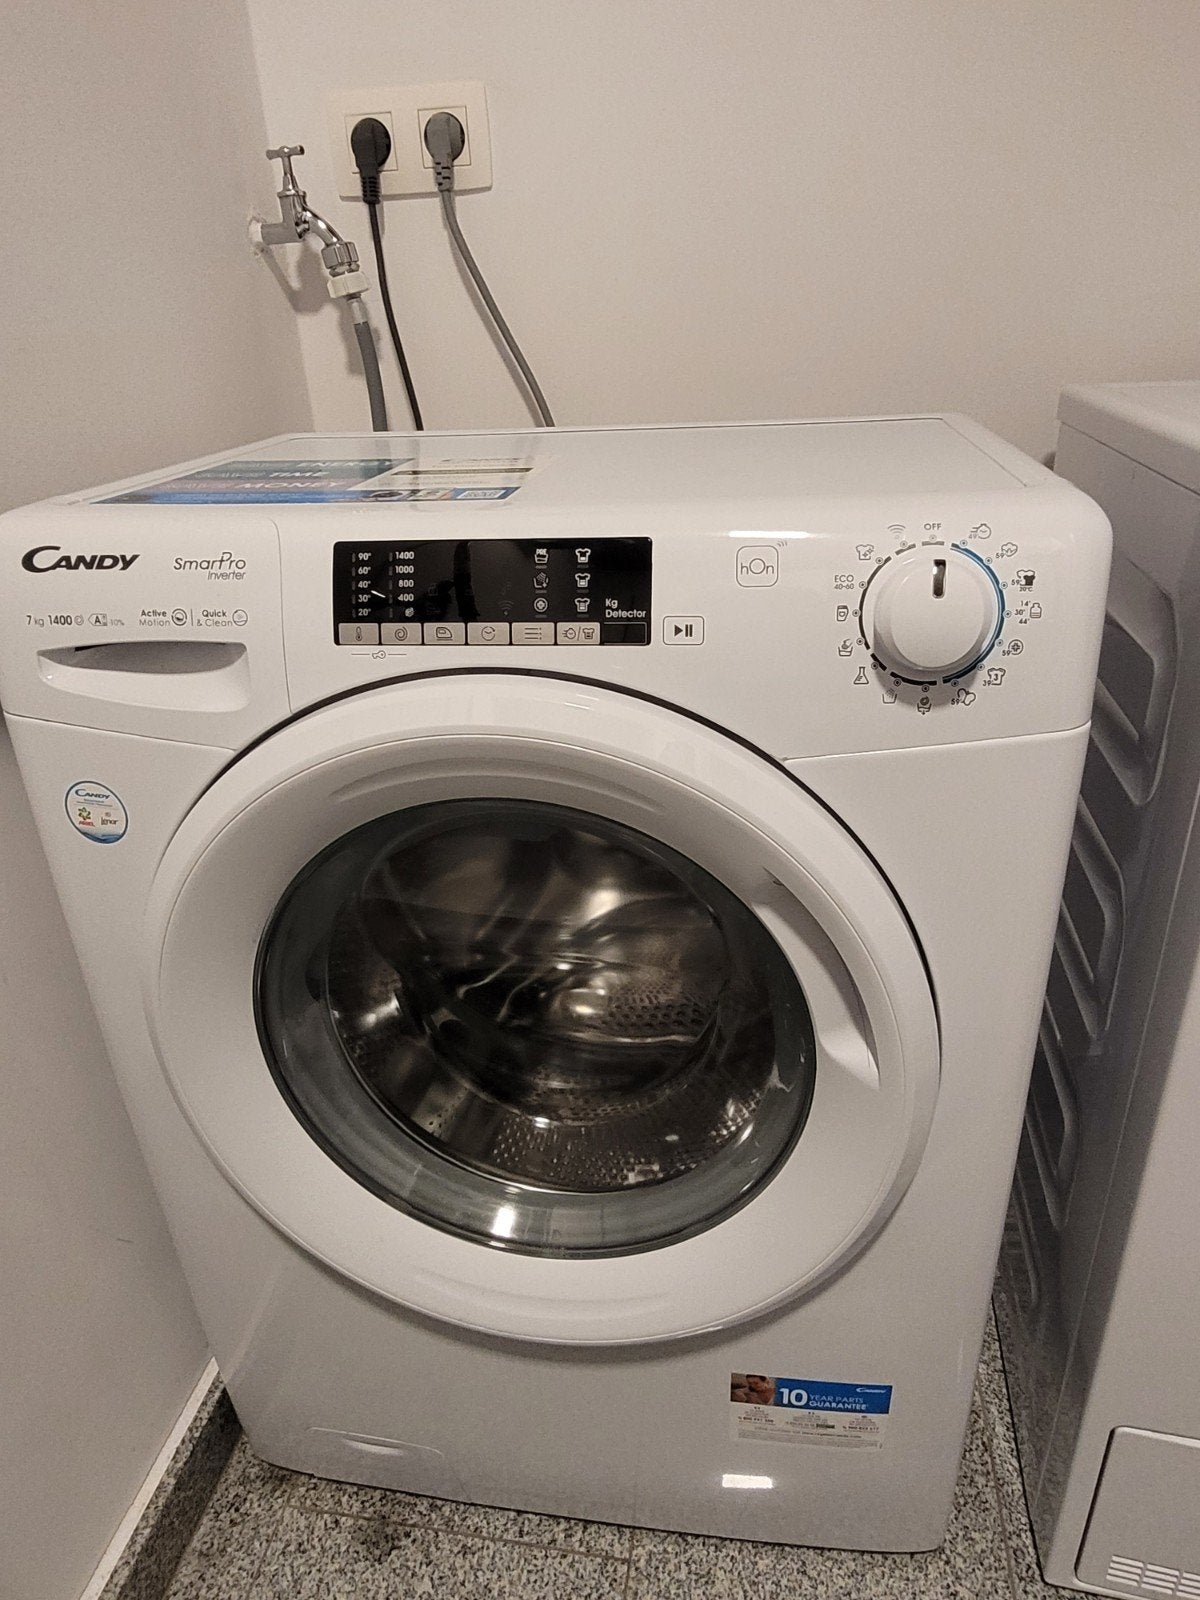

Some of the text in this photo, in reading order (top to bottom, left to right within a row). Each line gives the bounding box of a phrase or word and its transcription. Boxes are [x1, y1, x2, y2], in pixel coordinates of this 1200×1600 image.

[21, 545, 140, 573] CANDY
[395, 551, 415, 560] 1400
[395, 565, 414, 574] 1000
[740, 558, 774, 575] hOn
[207, 570, 246, 581] Inverter
[834, 574, 855, 583] ECO
[398, 579, 414, 588] 800
[397, 593, 414, 602] 400
[605, 599, 618, 609] Kg
[140, 608, 168, 618] Active
[201, 608, 228, 619] Quick
[605, 608, 647, 618] Detector
[26, 614, 32, 625] 7
[34, 617, 45, 628] kg
[48, 614, 73, 626] 1400
[139, 619, 171, 627] Motion
[204, 619, 233, 627] Clean
[779, 1387, 808, 1406] 10
[809, 1393, 864, 1405] YEAR PARTS
[809, 1400, 867, 1411] GUARANTEE
